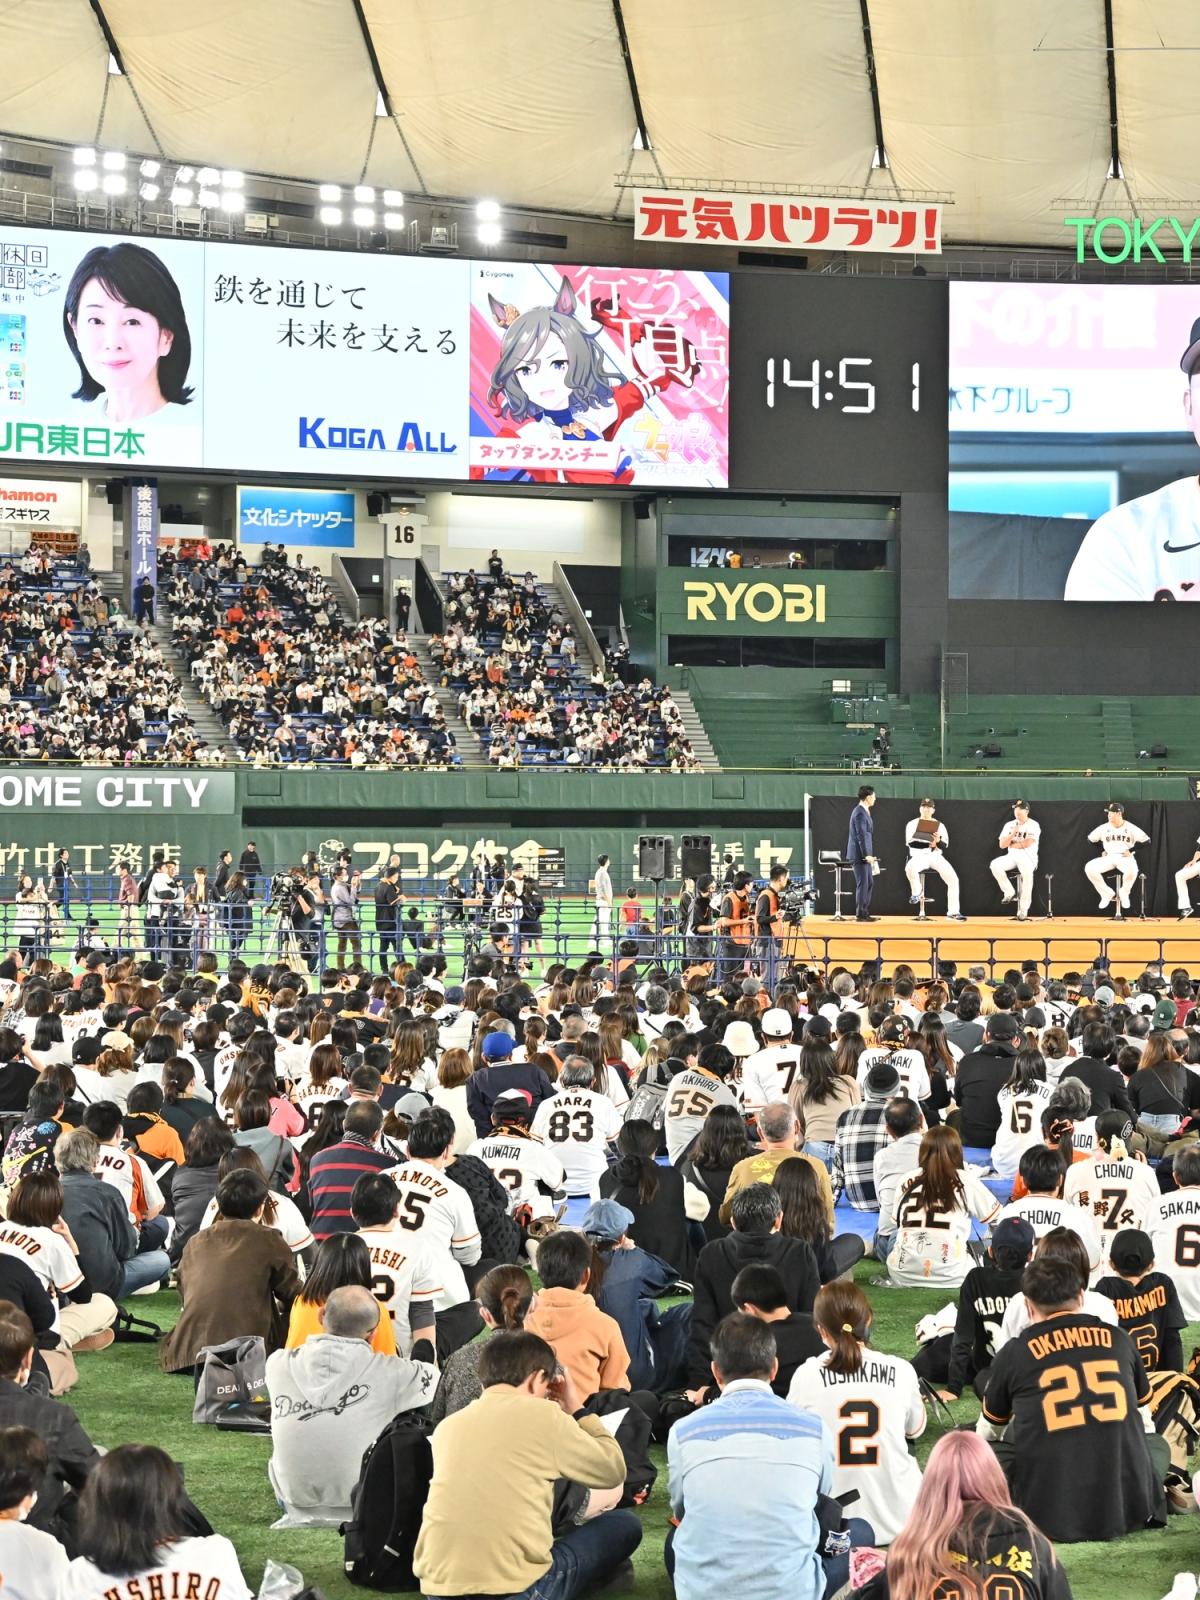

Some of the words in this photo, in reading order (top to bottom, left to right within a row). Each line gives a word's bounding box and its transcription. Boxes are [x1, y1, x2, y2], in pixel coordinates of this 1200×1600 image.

[639, 196, 938, 250] 元気ハツラツ!
[214, 274, 367, 310] 鉄を通じて
[485, 270, 514, 279] Cygames
[277, 318, 457, 355] 未来を支える
[0, 422, 146, 458] JR東日本
[299, 416, 386, 449] KOGA
[397, 421, 458, 453] ALL
[479, 443, 609, 462] タップダンスシチー
[137, 484, 153, 574] 後楽園ホール
[394, 525, 415, 543] 16
[684, 581, 826, 623] RYOBI
[96, 776, 209, 808] CITY
[680, 1074, 720, 1093] AKIHIRO
[553, 1096, 593, 1110] HARA
[667, 1089, 715, 1119] 55
[548, 1110, 595, 1143] 83
[481, 1145, 521, 1161] KUWATA
[1094, 1163, 1134, 1180] CHONO
[398, 1190, 433, 1232] 5
[1101, 1188, 1128, 1231] 7
[1027, 1325, 1113, 1361] OKAMOTO
[1038, 1359, 1129, 1432] 25
[838, 1399, 880, 1467] 2
